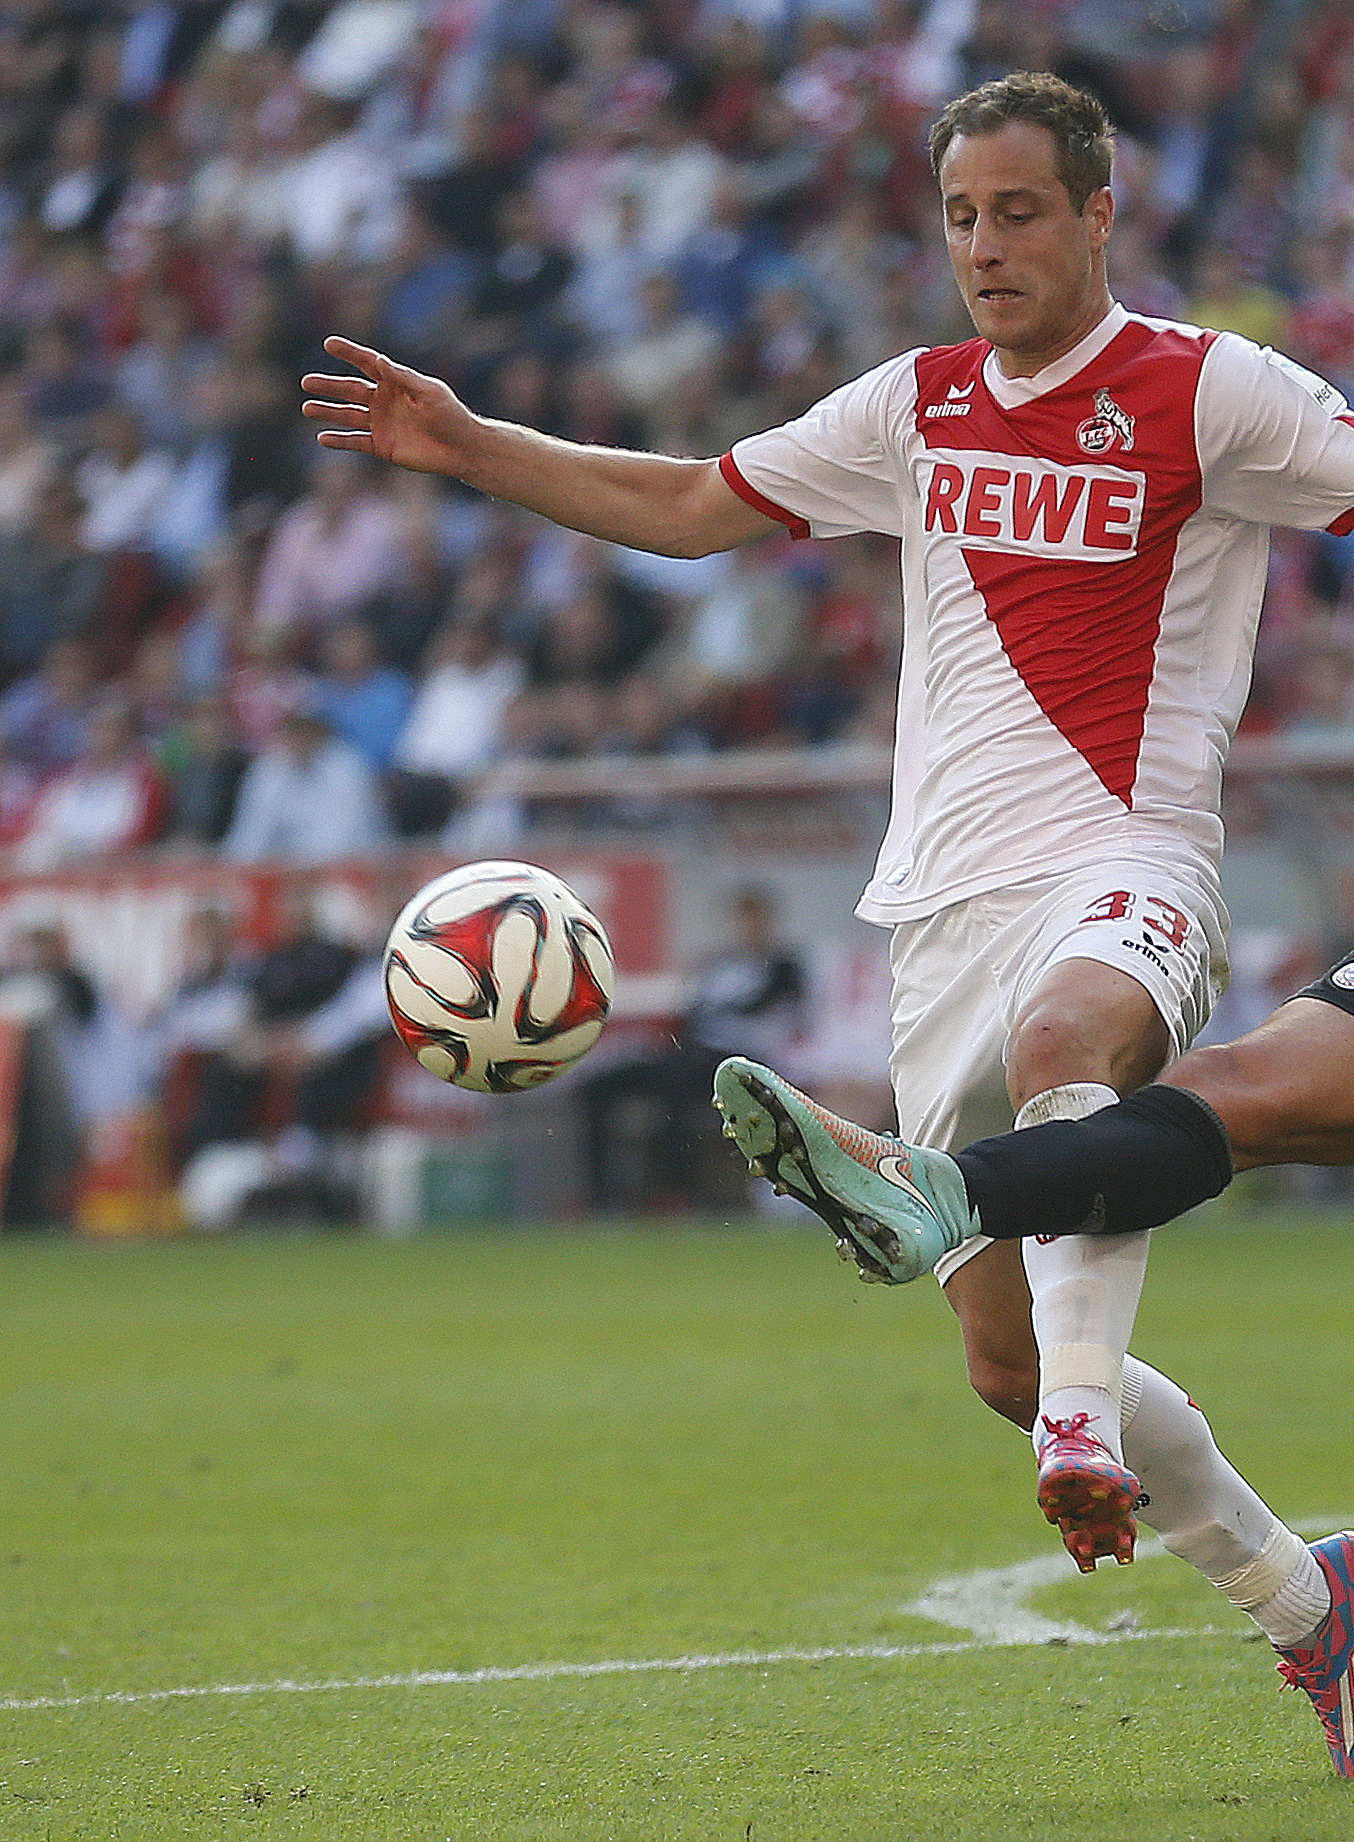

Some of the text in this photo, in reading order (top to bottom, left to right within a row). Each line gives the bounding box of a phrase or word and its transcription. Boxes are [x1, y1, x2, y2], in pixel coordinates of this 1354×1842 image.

[925, 401, 971, 417] erima
[925, 463, 1138, 550] REWE
[1078, 890, 1192, 956] 33
[1122, 939, 1170, 977] erima
